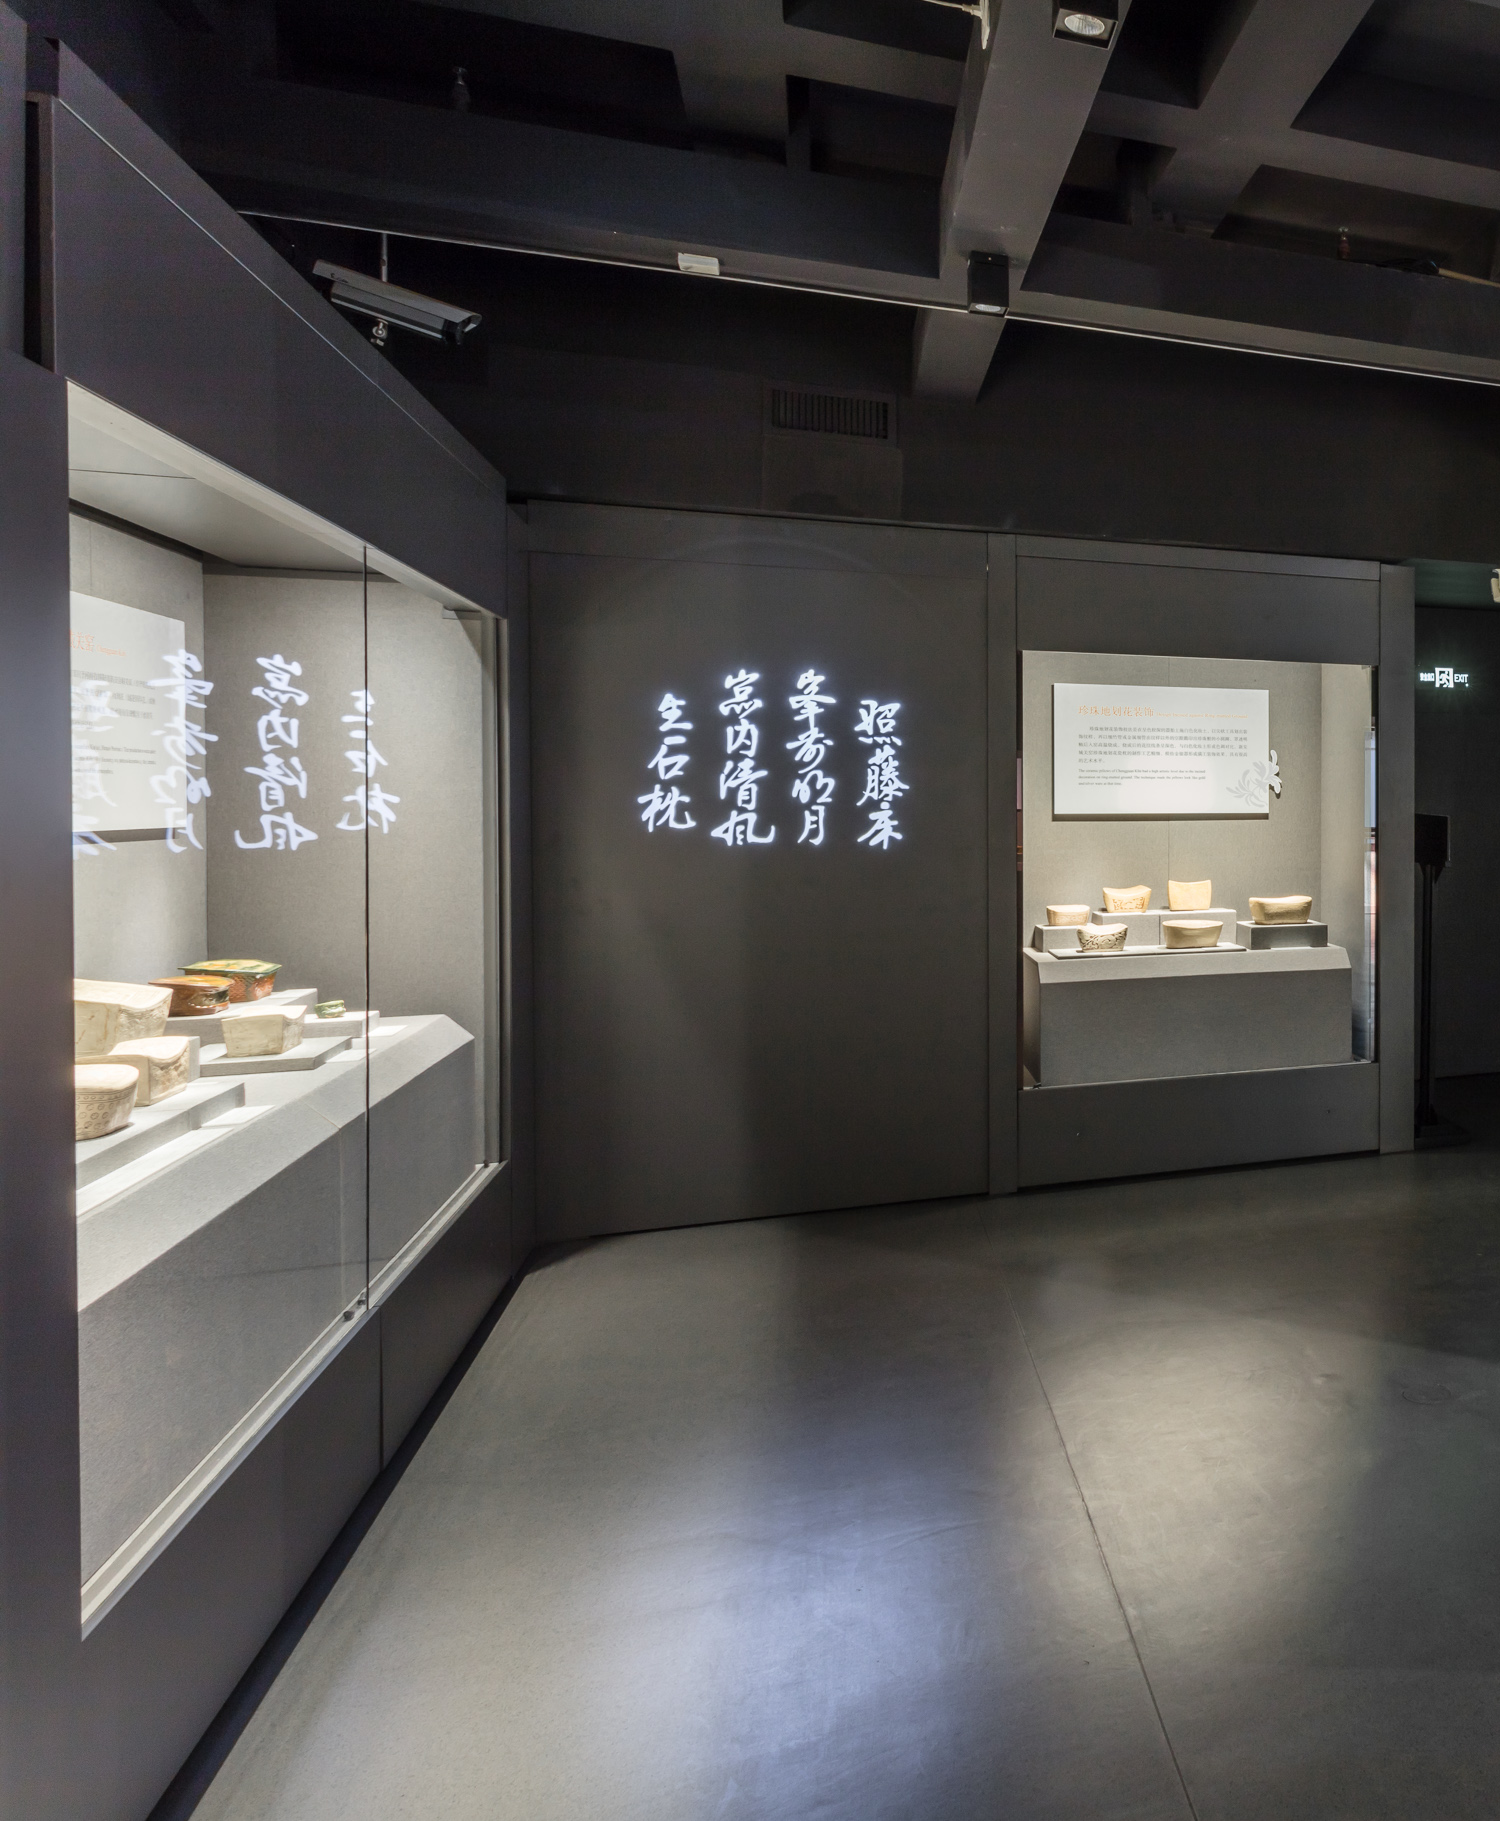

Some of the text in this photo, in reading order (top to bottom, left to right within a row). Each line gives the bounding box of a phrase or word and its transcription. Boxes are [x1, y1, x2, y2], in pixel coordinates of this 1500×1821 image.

[1454, 674, 1469, 683] EXIT
[1078, 705, 1154, 718] 珍珠地划花装饰
